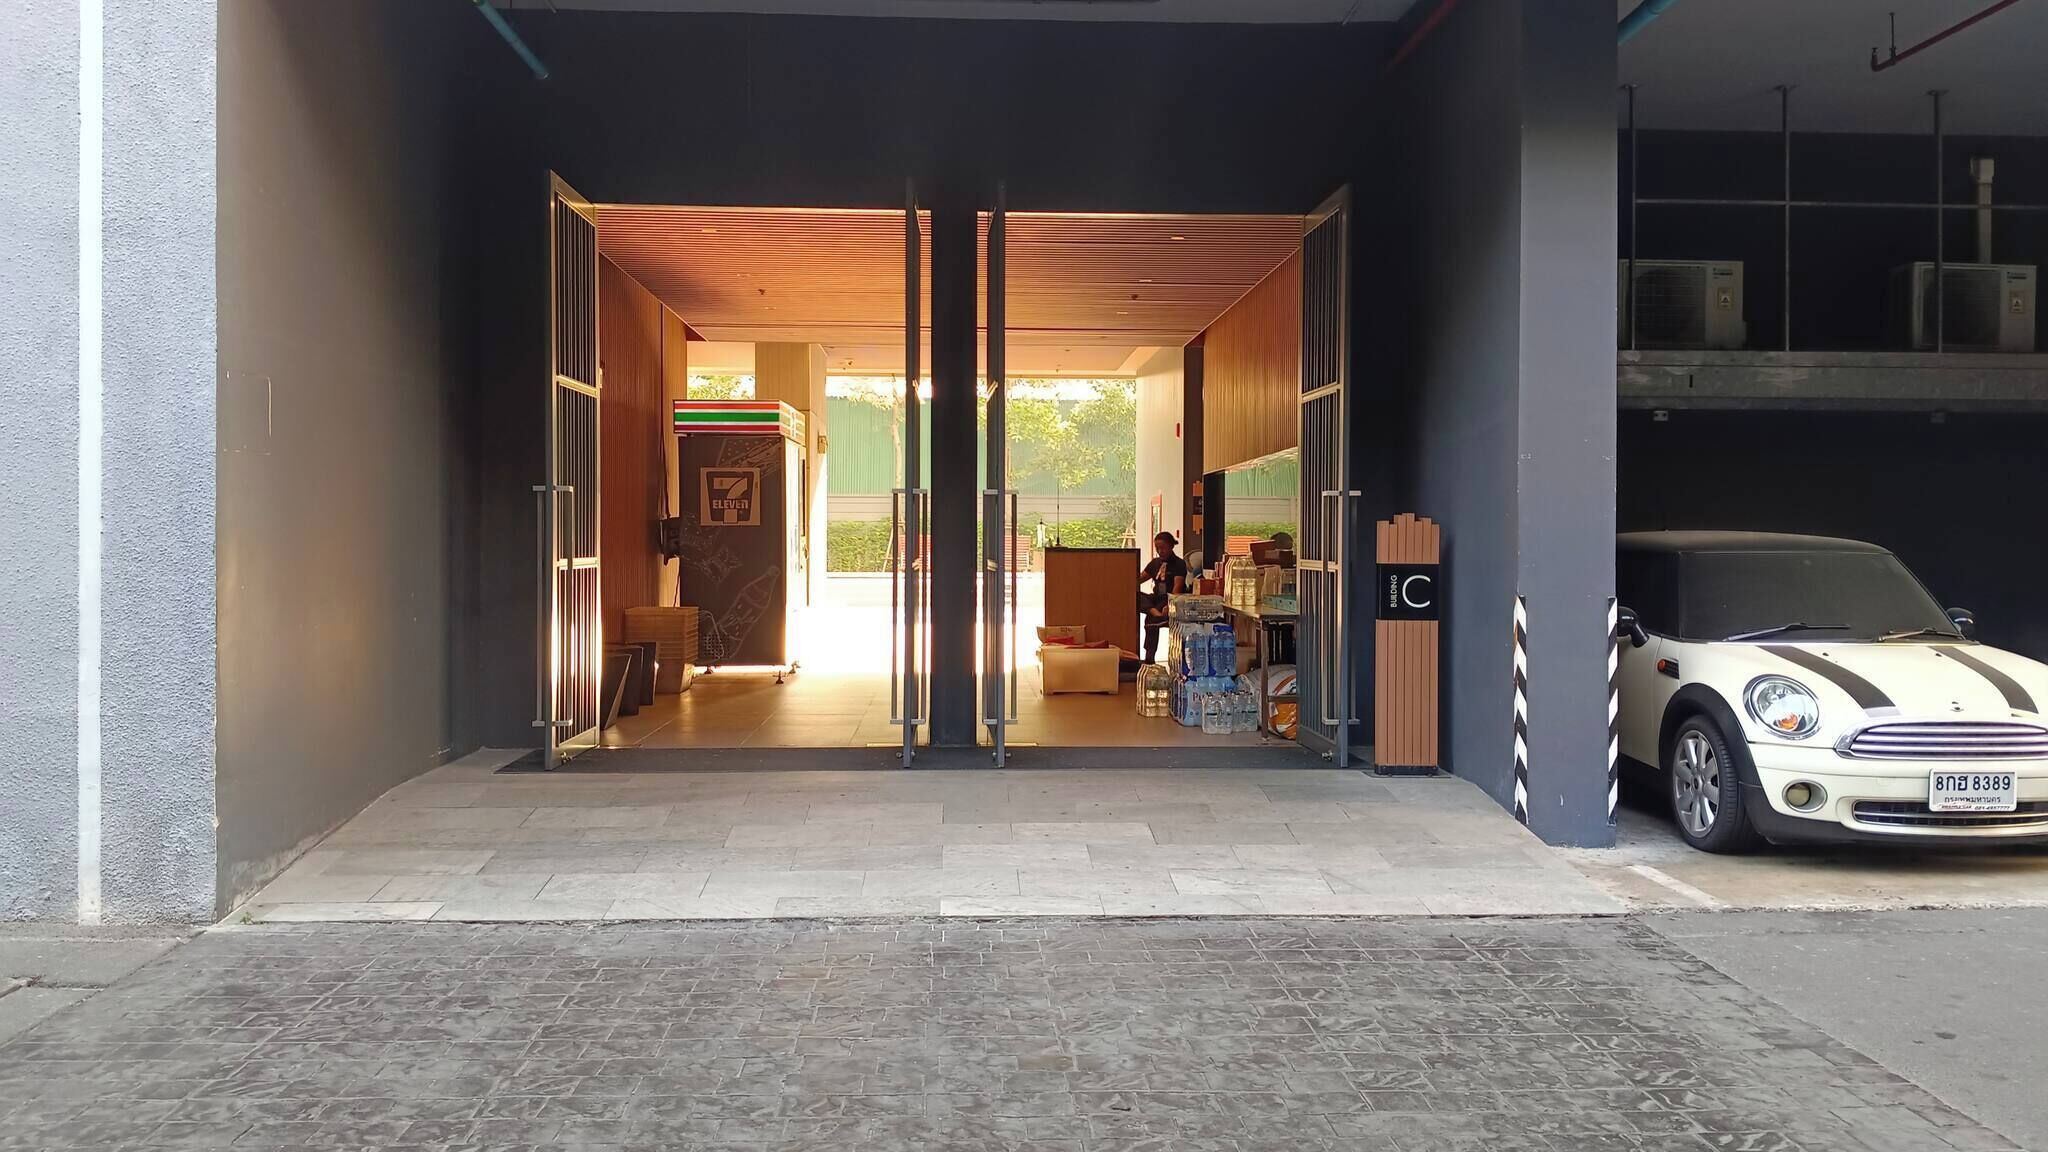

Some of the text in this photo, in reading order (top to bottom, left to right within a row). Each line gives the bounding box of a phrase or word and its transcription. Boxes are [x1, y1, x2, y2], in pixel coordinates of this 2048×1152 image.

[1390, 574, 1398, 608] BUILDING
[1402, 575, 1431, 608] C
[1936, 775, 2011, 791] 8กฮ 8389
